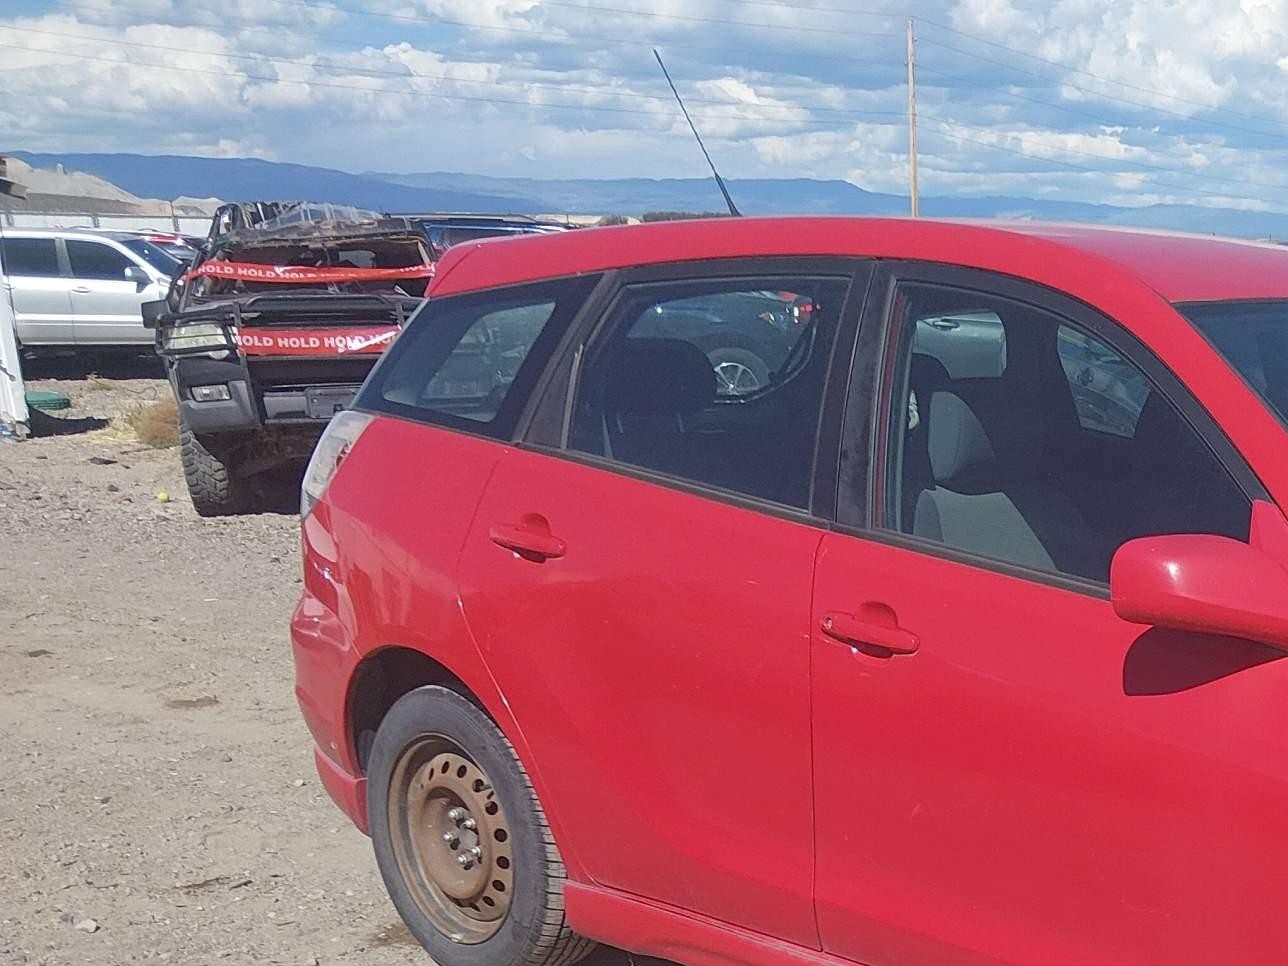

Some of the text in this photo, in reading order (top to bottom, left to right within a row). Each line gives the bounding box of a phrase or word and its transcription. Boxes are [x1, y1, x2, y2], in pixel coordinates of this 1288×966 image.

[198, 264, 234, 274] HOLD
[238, 267, 275, 278] HOLD
[278, 337, 320, 348] HOLD
